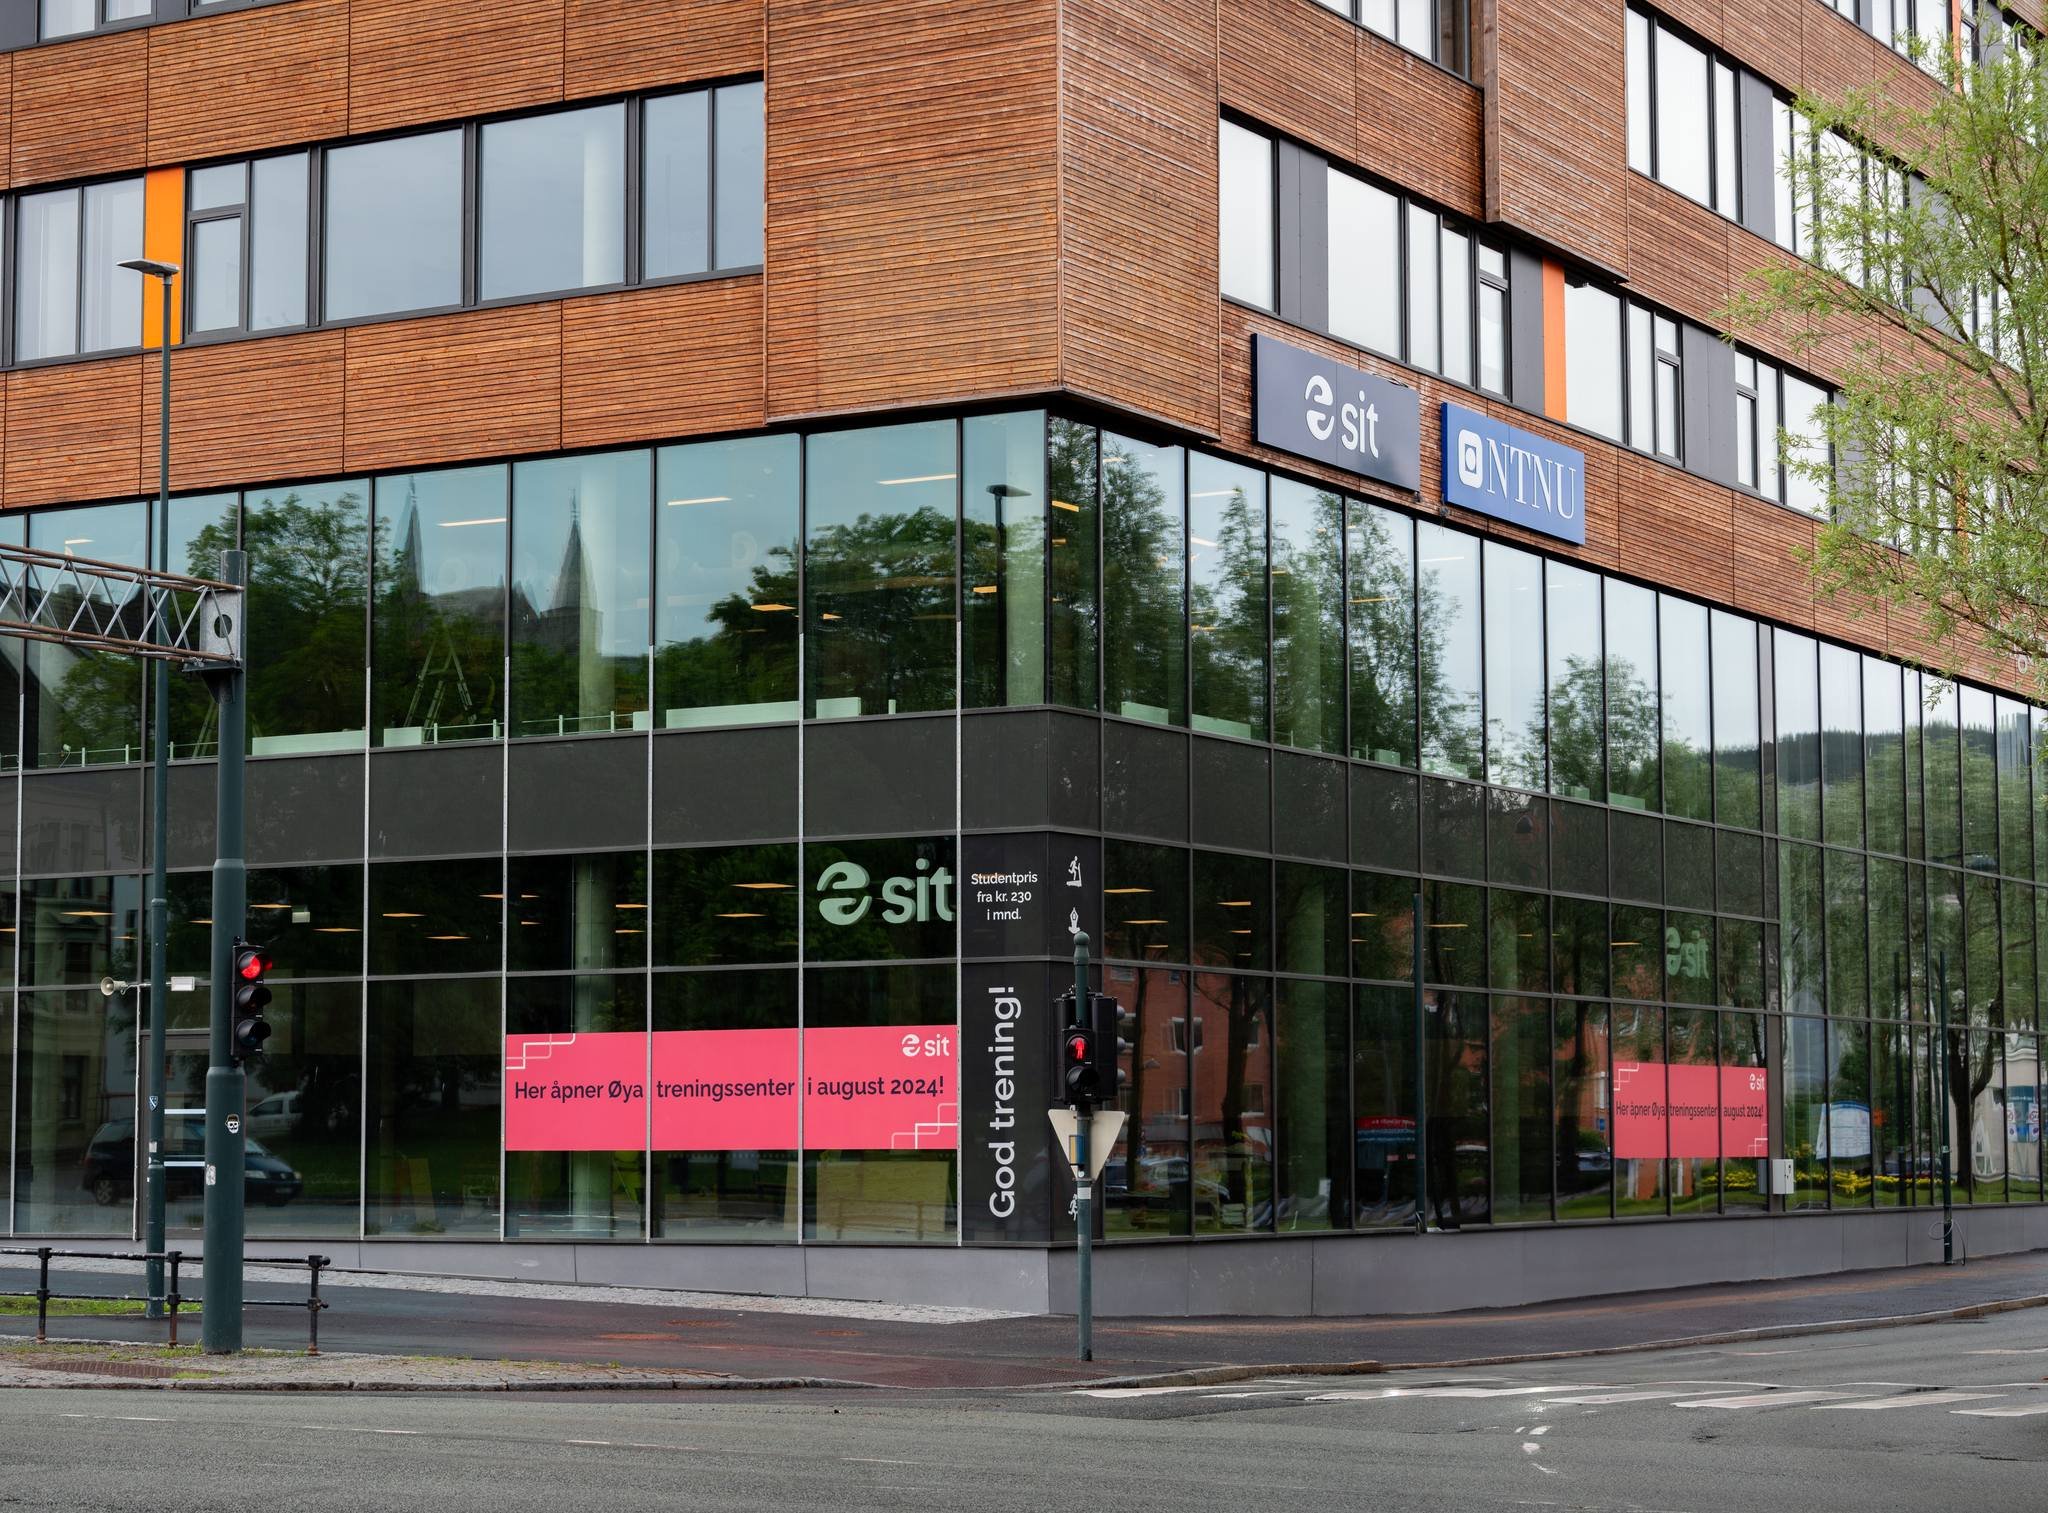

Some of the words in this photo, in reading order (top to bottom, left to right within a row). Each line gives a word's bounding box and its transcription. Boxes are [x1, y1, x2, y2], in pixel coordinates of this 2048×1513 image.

[1486, 438, 1577, 520] NTNU
[971, 871, 1038, 885] Studentpris
[976, 891, 993, 903] fra
[995, 891, 1009, 903] kr.
[1011, 891, 1032, 903] 230
[986, 908, 990, 920] i
[993, 908, 1022, 921] mnd.
[988, 986, 1022, 1130] trening!
[515, 1081, 547, 1099] Her
[551, 1080, 604, 1103] åpner
[608, 1080, 644, 1103] Øya
[656, 1078, 795, 1102] treningssenter
[807, 1077, 812, 1096] i
[817, 1077, 885, 1101] august
[890, 1076, 944, 1098] 2024!
[1616, 1101, 1629, 1115] Her
[1630, 1101, 1651, 1120] åpner
[1652, 1102, 1666, 1120] Øya
[1669, 1103, 1719, 1121] treningssenter
[1723, 1104, 1746, 1121] august
[988, 1141, 1016, 1218] Good
